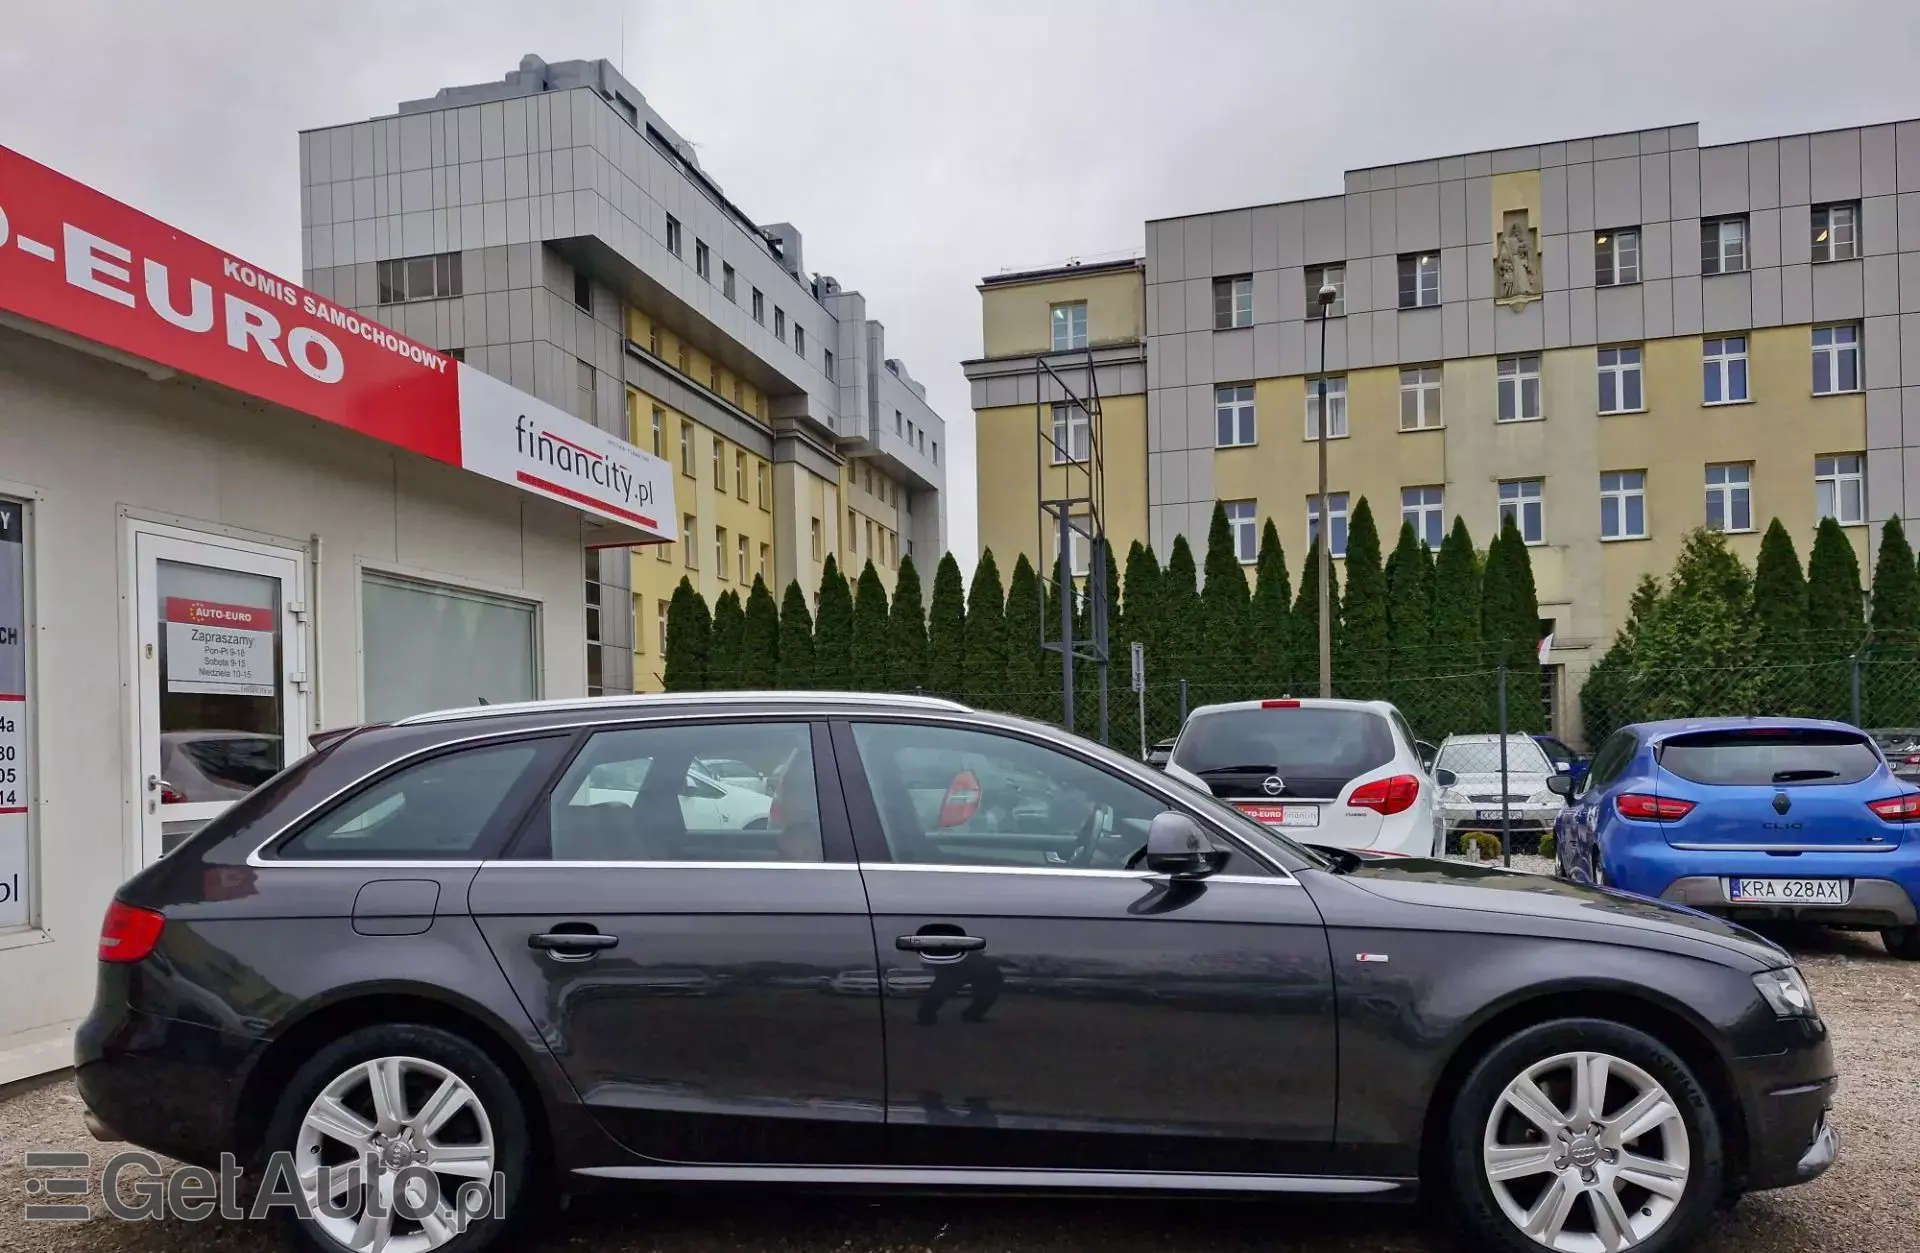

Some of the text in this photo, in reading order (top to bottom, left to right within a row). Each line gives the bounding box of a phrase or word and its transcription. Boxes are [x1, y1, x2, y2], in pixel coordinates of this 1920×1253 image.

[0, 205, 345, 384] -EURO
[223, 257, 448, 374] KOMIS SAMOCHODOWY
[515, 414, 654, 507] financity.pl
[196, 607, 252, 622] AUTO-EURO
[191, 628, 254, 648] Zapraszamy
[229, 647, 246, 657] 9-18
[204, 657, 246, 668] Sobota 9-15
[199, 667, 252, 679] Niedziela 10-15
[1762, 822, 1803, 830] CLIO
[1741, 881, 1838, 898] KRA 628AX
